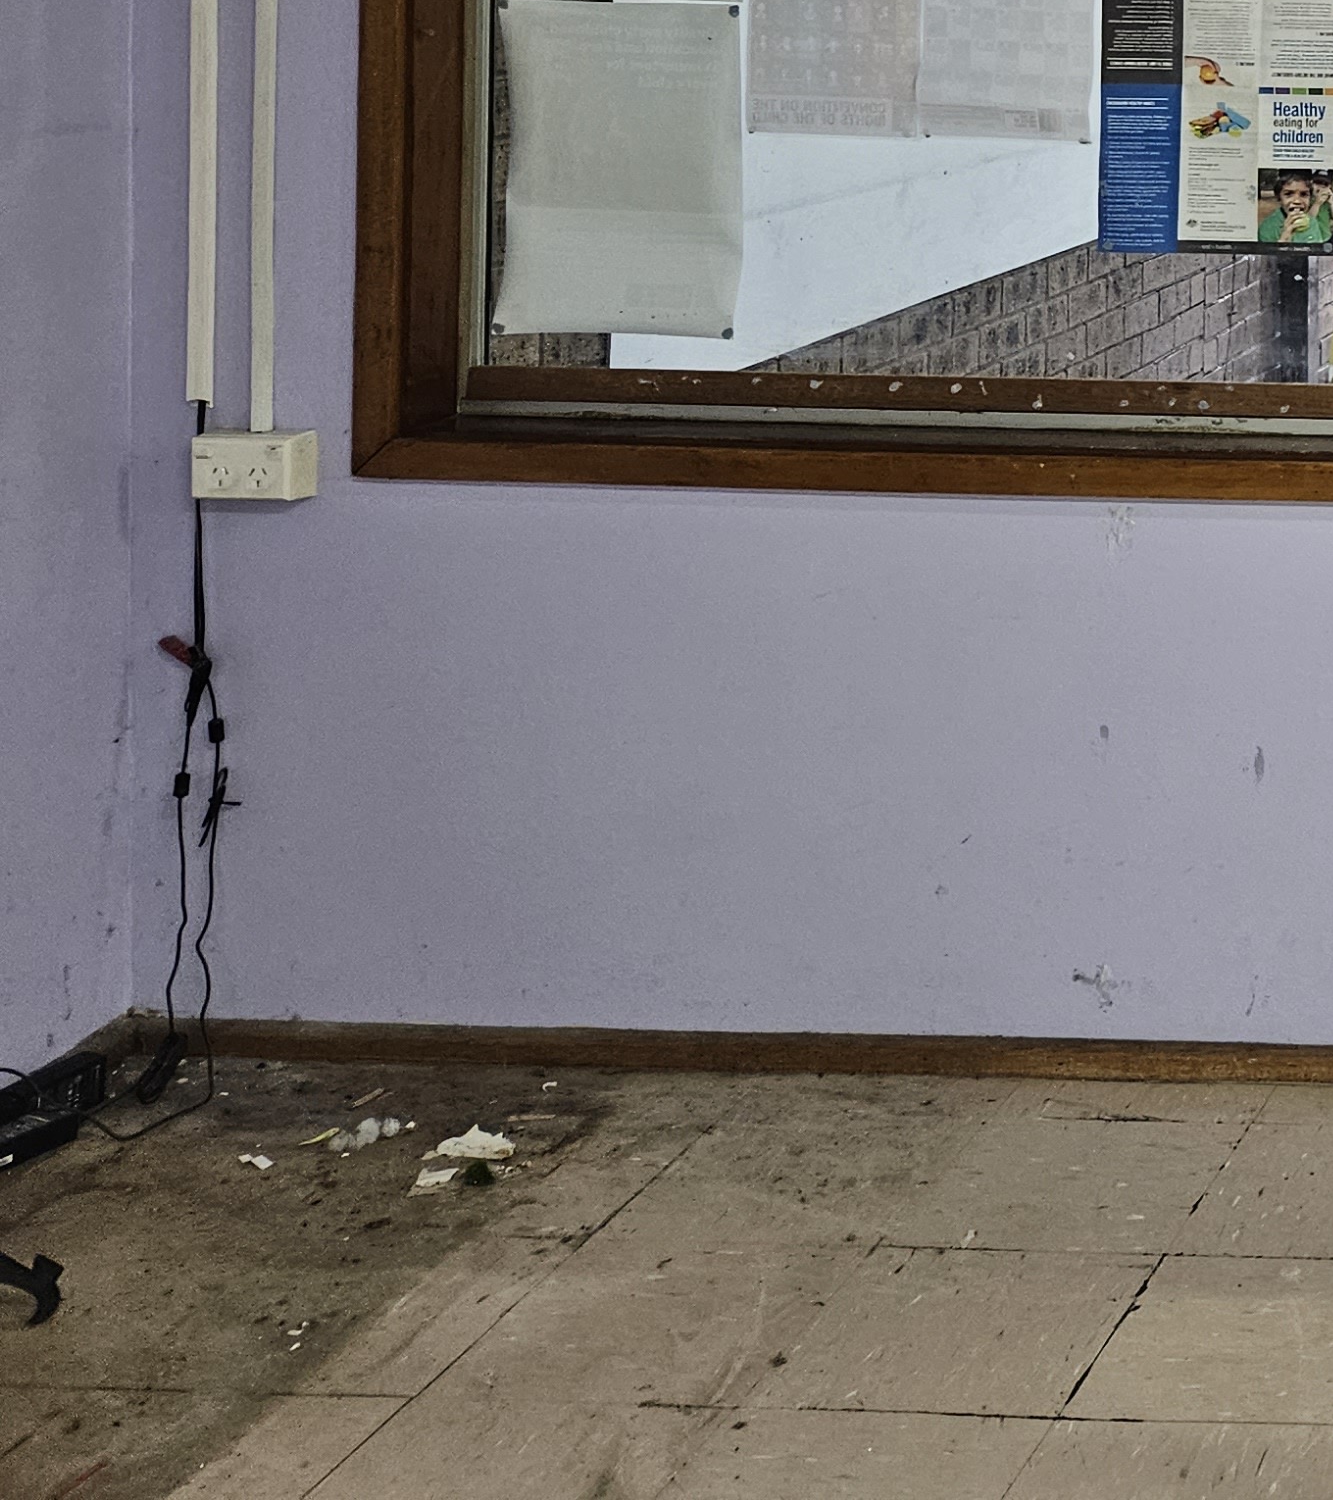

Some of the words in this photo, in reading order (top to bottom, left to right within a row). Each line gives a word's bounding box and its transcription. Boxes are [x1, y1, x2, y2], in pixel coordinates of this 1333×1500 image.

[1273, 102, 1326, 120] Healthy
[1273, 118, 1302, 130] eating
[1306, 118, 1318, 128] for
[1272, 129, 1323, 143] children
